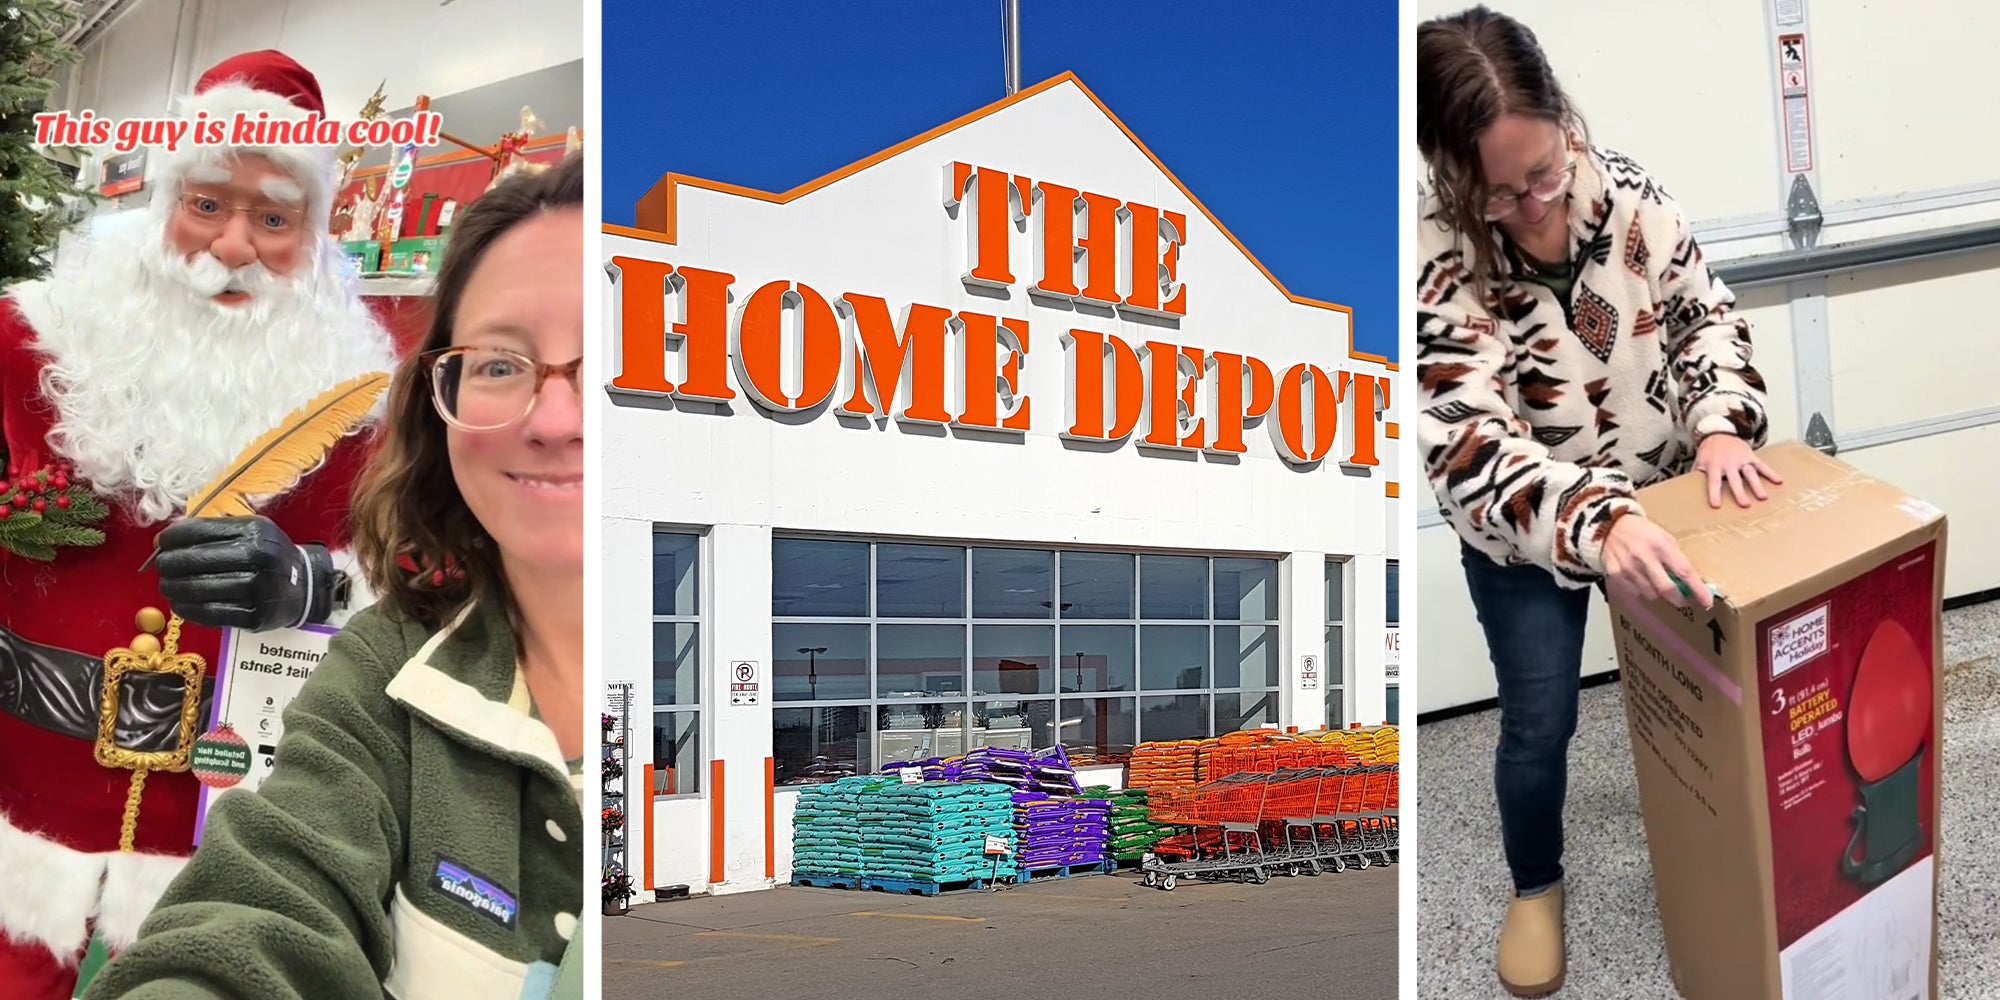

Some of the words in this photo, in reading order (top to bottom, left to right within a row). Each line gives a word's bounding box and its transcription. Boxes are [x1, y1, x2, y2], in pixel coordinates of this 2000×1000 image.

[945, 161, 1187, 317] THE
[606, 255, 1031, 434] HOME
[1062, 328, 1390, 467] DEPOT
[1792, 615, 1825, 639] HOME
[1775, 627, 1825, 661] ACCENTS
[1789, 641, 1825, 663] Holiday
[1633, 628, 1669, 672] MONTH
[1671, 664, 1704, 702] LONG
[1771, 687, 1786, 715] 3
[1789, 688, 1831, 719] BATTERY
[1790, 698, 1838, 731] OPERATED
[1791, 725, 1814, 745] LED
[1818, 710, 1843, 731] Jumbo
[1793, 743, 1812, 760] Bulb
